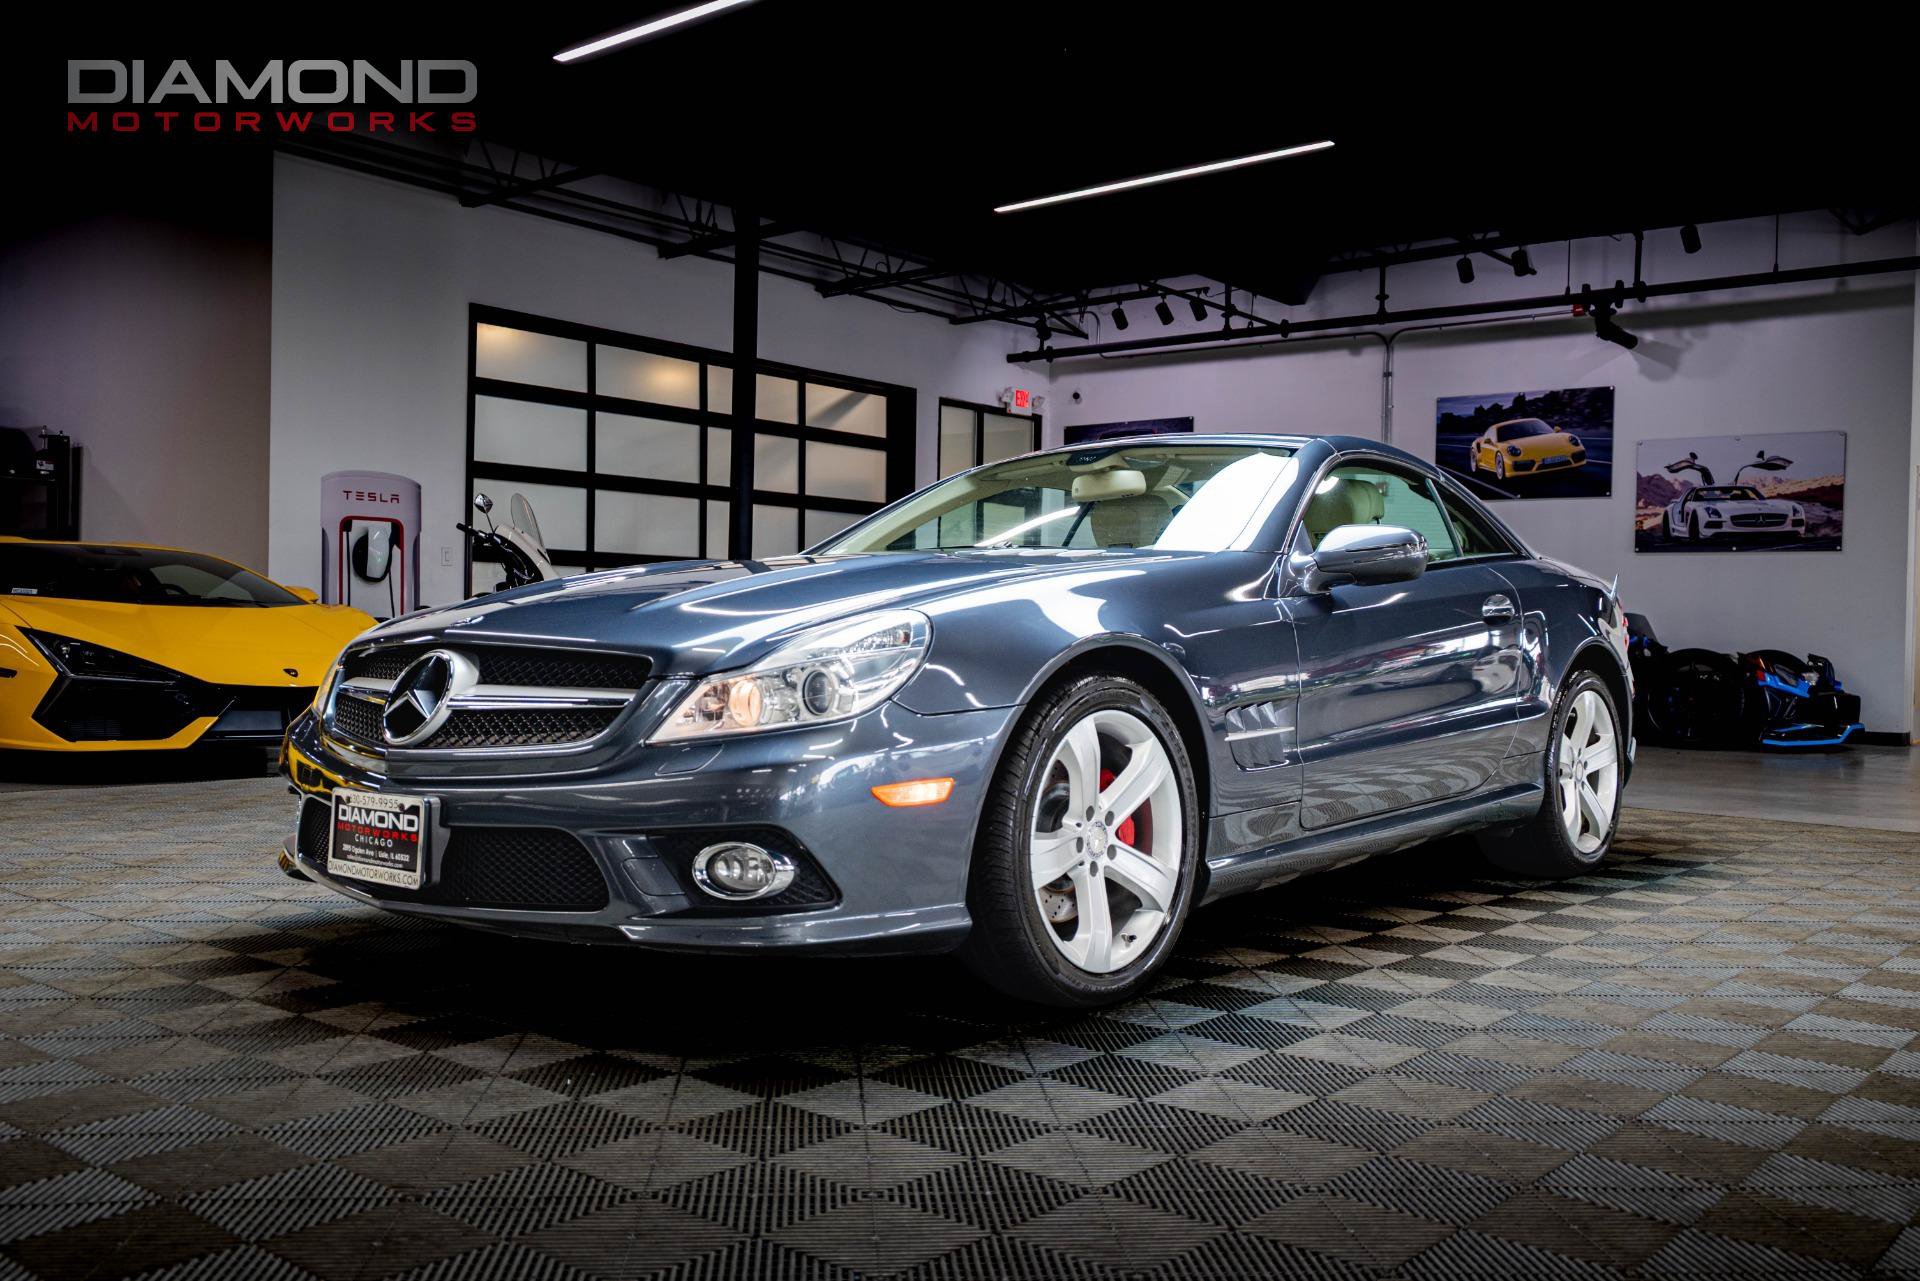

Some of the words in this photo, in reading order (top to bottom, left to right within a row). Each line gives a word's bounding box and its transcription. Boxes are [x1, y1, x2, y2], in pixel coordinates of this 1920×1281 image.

[342, 490, 400, 504] TESLA
[350, 794, 399, 810] 30-579-9955
[338, 804, 419, 832] DIAMOND
[337, 821, 418, 843] MOTORWORKS
[354, 834, 393, 848] CHICAGO
[328, 860, 419, 886] DIAMONDMOTORWORKS.COM
